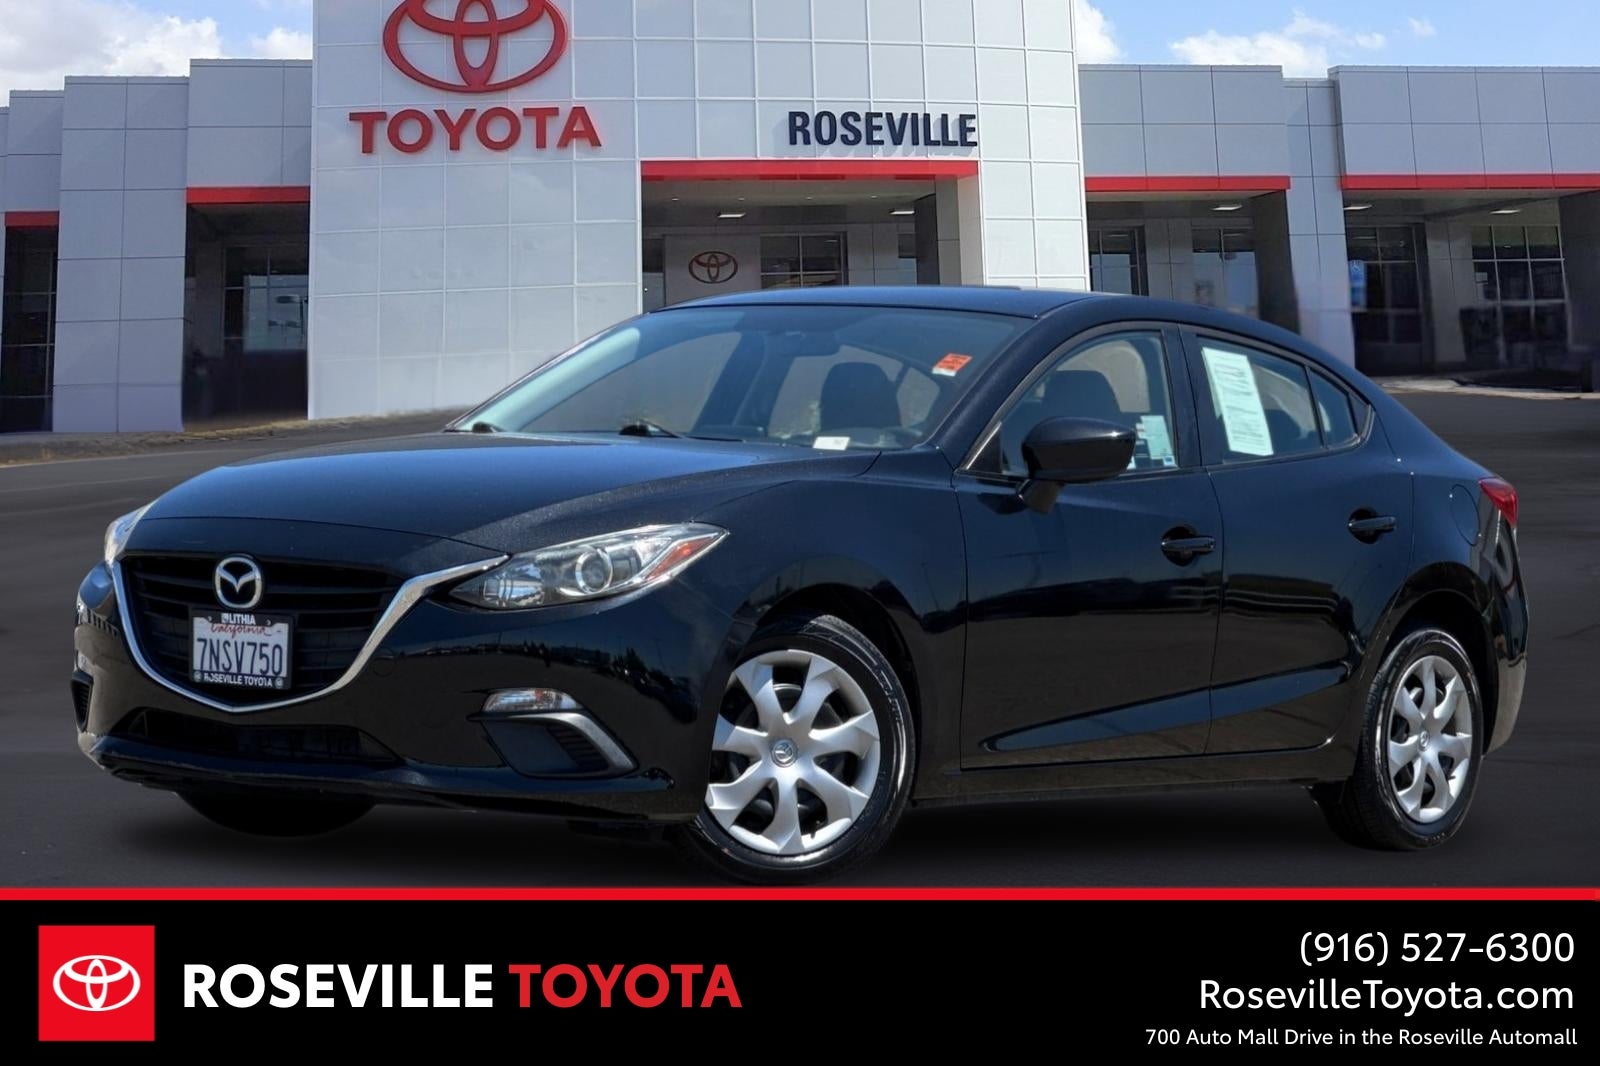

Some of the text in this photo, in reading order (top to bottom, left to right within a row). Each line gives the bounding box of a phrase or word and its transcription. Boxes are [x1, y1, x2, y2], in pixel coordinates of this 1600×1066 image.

[350, 106, 602, 154] TOYOTA
[789, 111, 978, 147] ROSEVILLE
[229, 613, 257, 625] LITHIA
[196, 638, 283, 676] 7NSV750
[203, 672, 273, 687] ROSEVILLE TOYOTA
